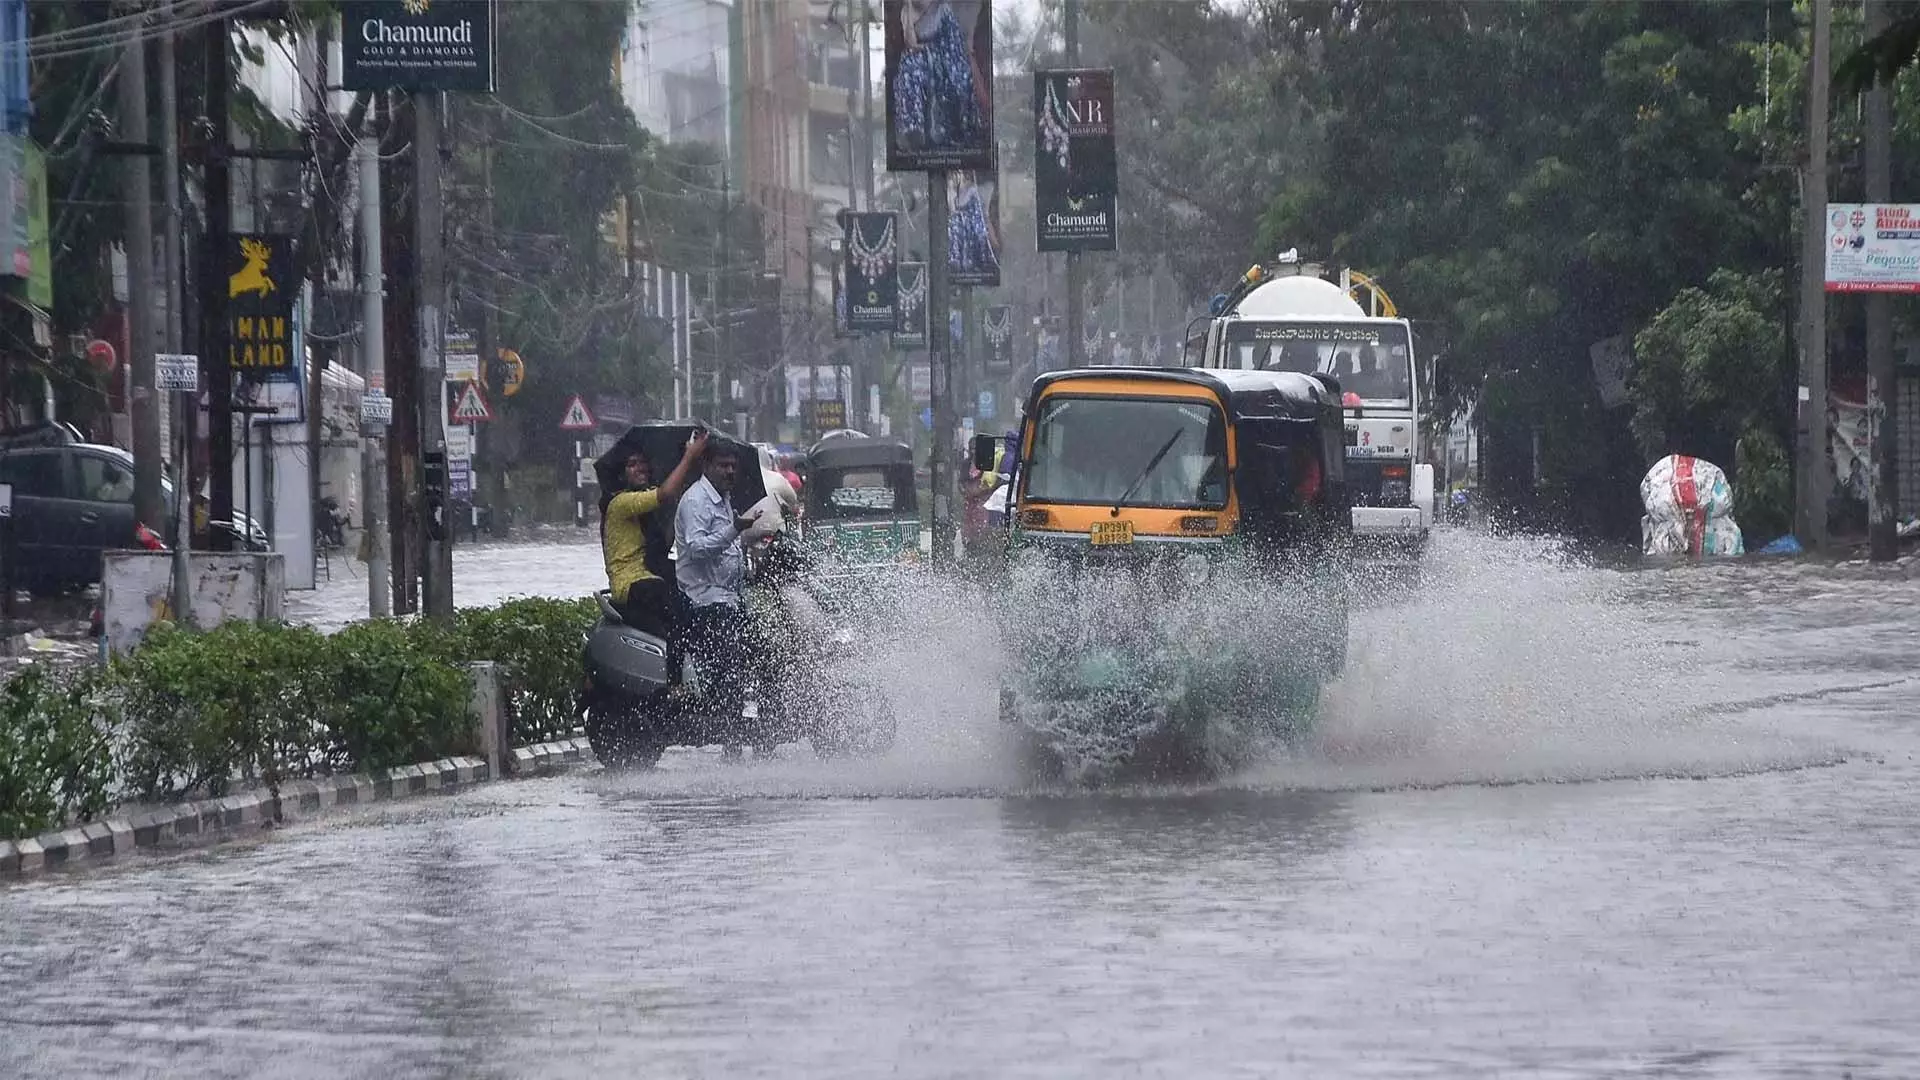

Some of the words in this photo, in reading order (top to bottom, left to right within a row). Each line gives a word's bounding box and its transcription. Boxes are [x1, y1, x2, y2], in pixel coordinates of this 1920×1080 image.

[362, 19, 472, 43] Chamundi
[363, 46, 394, 55] GOLD
[400, 46, 407, 55] &
[413, 46, 474, 56] DIAMONDS
[1066, 100, 1103, 123] NR
[1876, 208, 1910, 218] Study
[1047, 213, 1107, 226] Chamundi
[1865, 254, 1917, 266] Pegasus
[853, 305, 892, 314] Chamundi
[230, 343, 285, 367] LAND
